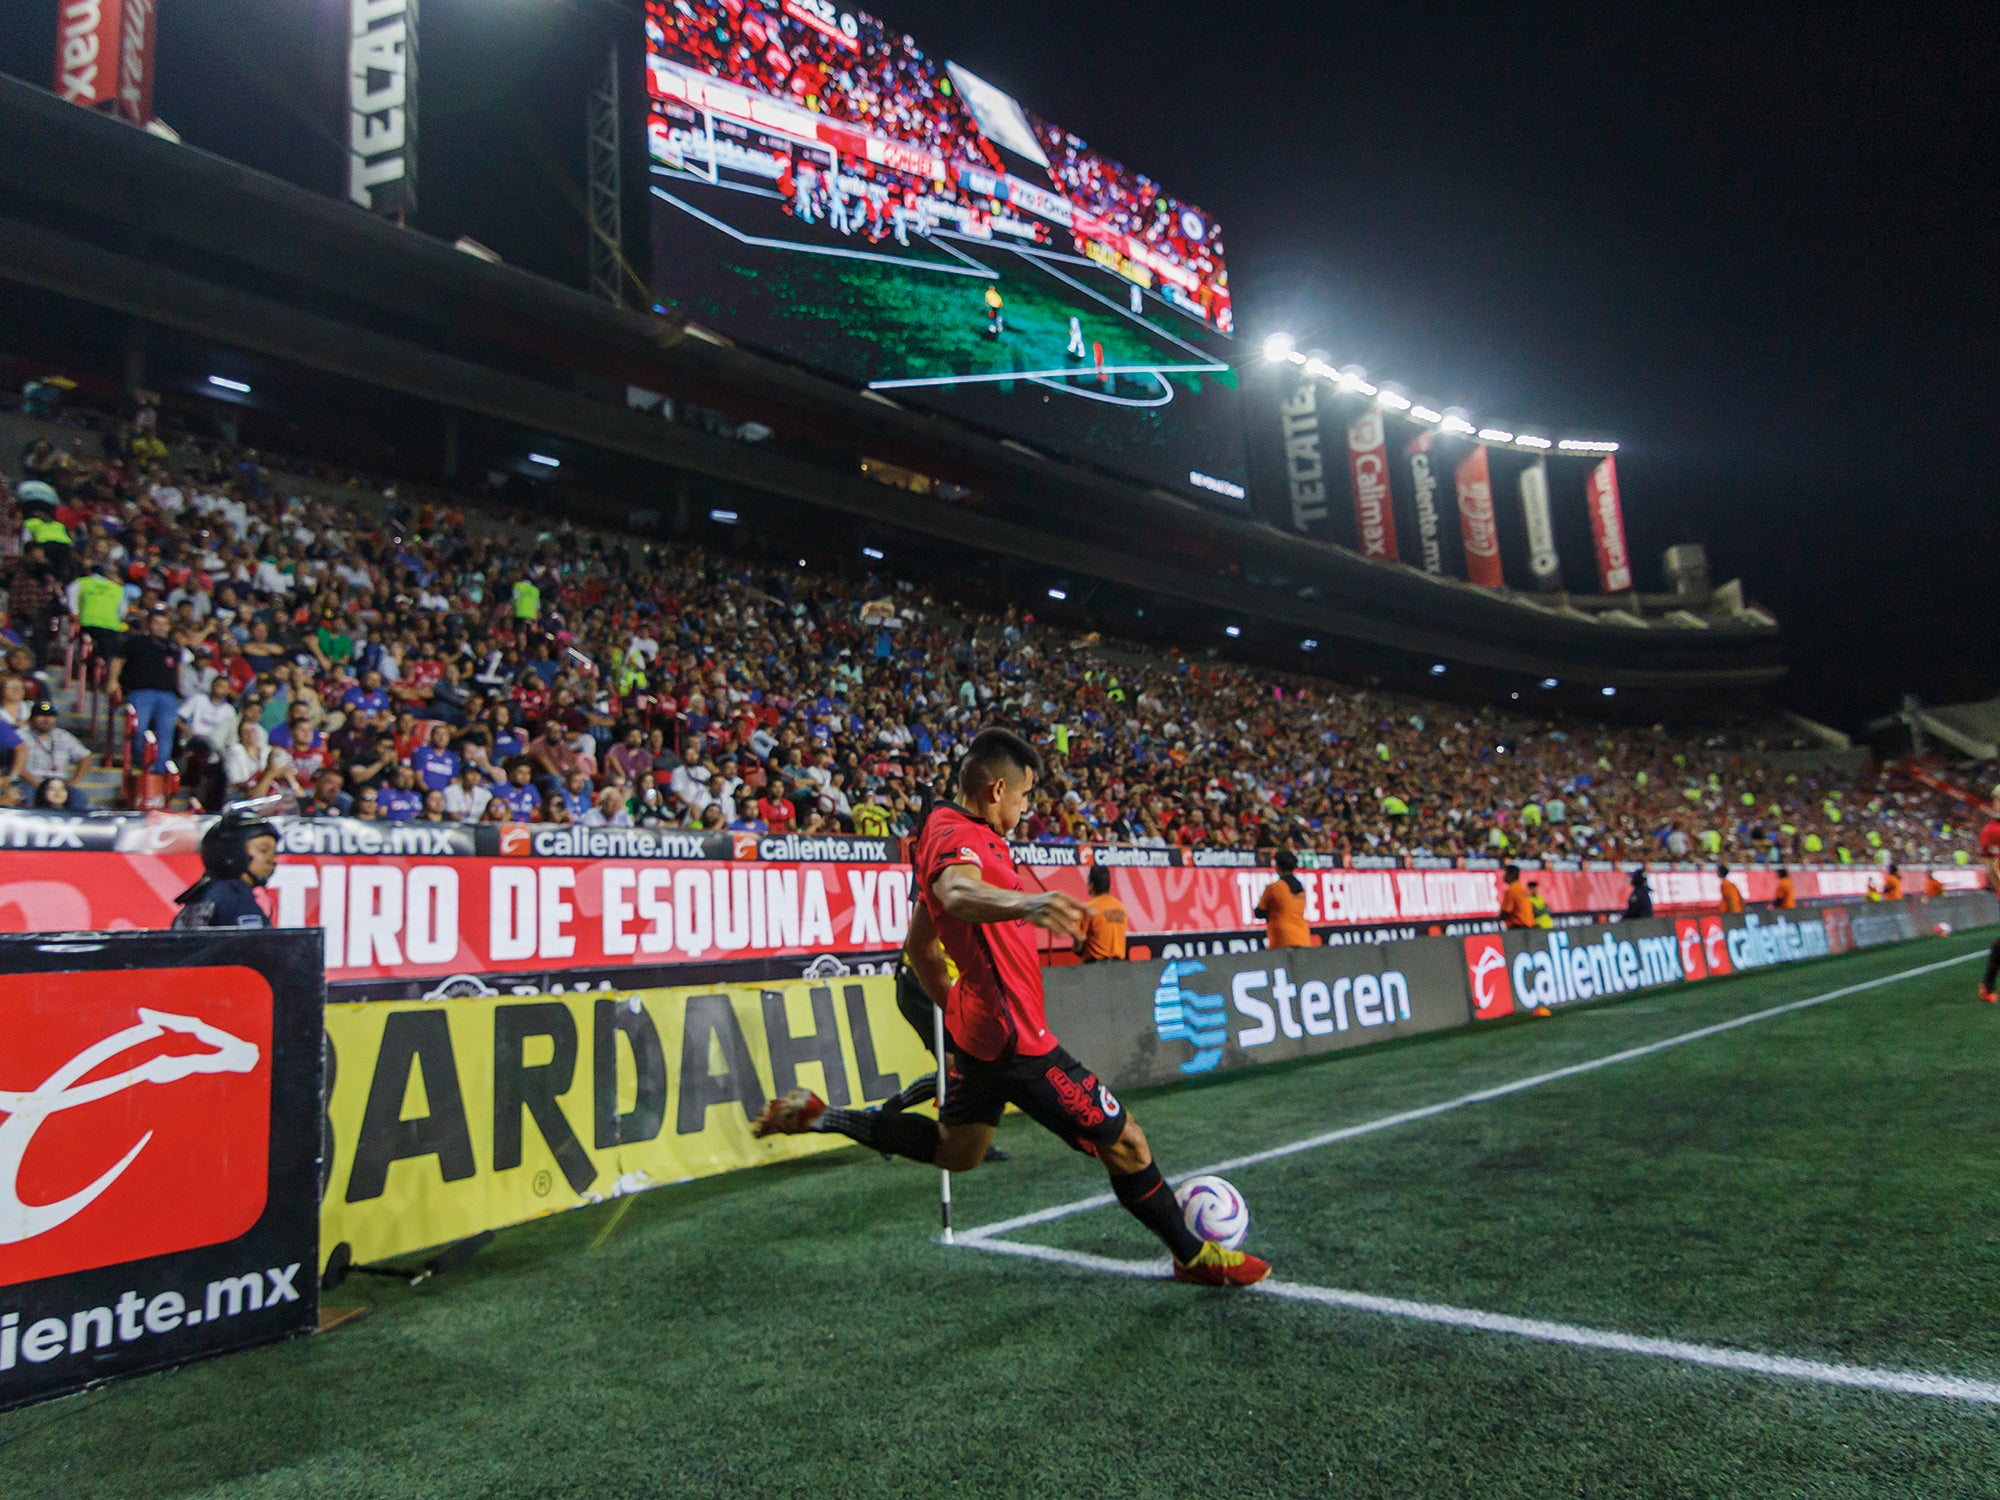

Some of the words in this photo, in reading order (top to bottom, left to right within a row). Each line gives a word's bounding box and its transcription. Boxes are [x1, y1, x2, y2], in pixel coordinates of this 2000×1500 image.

[1355, 453, 1386, 556] Calimax
[1411, 453, 1441, 574] caliente.mx
[533, 827, 706, 859] caliente.mx
[760, 834, 887, 861] caliente.mx
[1094, 846, 1170, 867] caliente.mx
[267, 864, 460, 969] TIRO
[490, 866, 576, 961] DE
[602, 867, 835, 957] ESQUINA
[1231, 968, 1412, 1048] Steren
[1512, 931, 1684, 1010] caliente.mx
[0, 1261, 301, 1372] iente.mx
